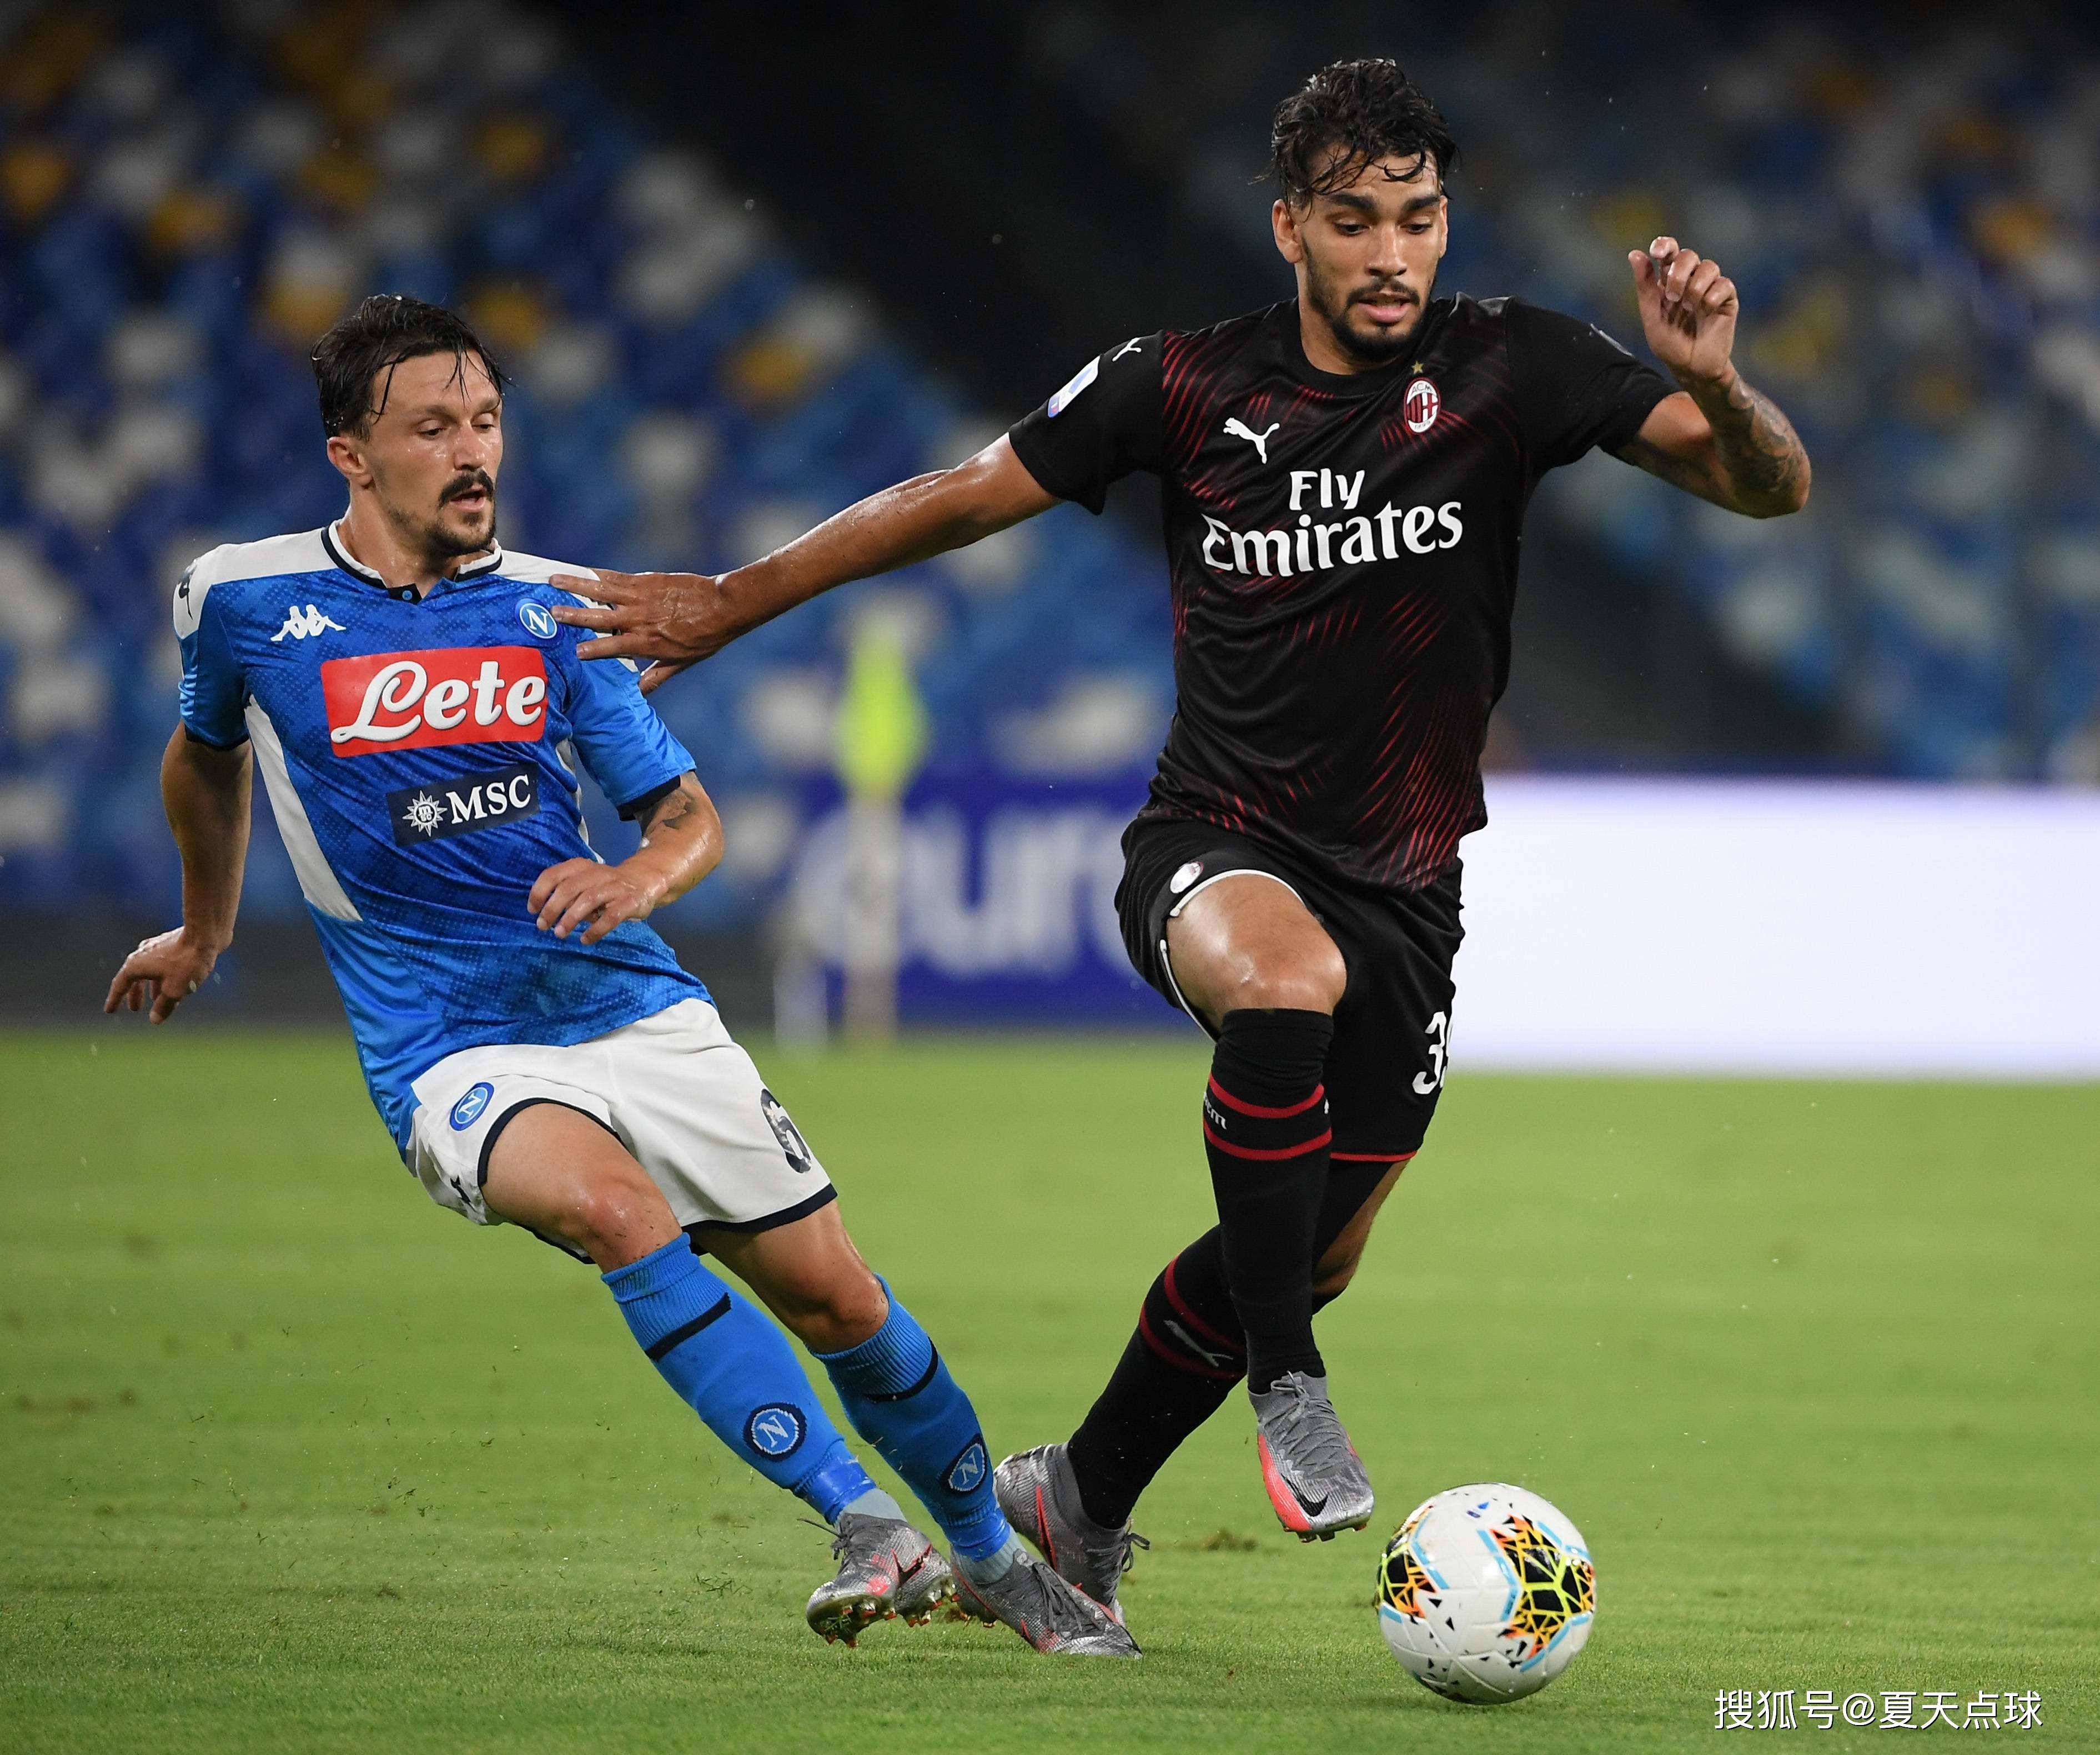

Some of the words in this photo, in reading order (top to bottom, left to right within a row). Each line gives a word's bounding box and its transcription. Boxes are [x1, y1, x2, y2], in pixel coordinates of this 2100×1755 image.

[1288, 468, 1365, 511] Fly
[1201, 500, 1463, 577] Emirates
[526, 608, 549, 634] N
[330, 660, 546, 744] Lete
[446, 774, 531, 824] MSC
[1411, 1011, 1453, 1095] 3
[458, 1092, 482, 1117] N
[760, 1089, 811, 1174] 6
[757, 1415, 789, 1447] N
[959, 1452, 979, 1485] N
